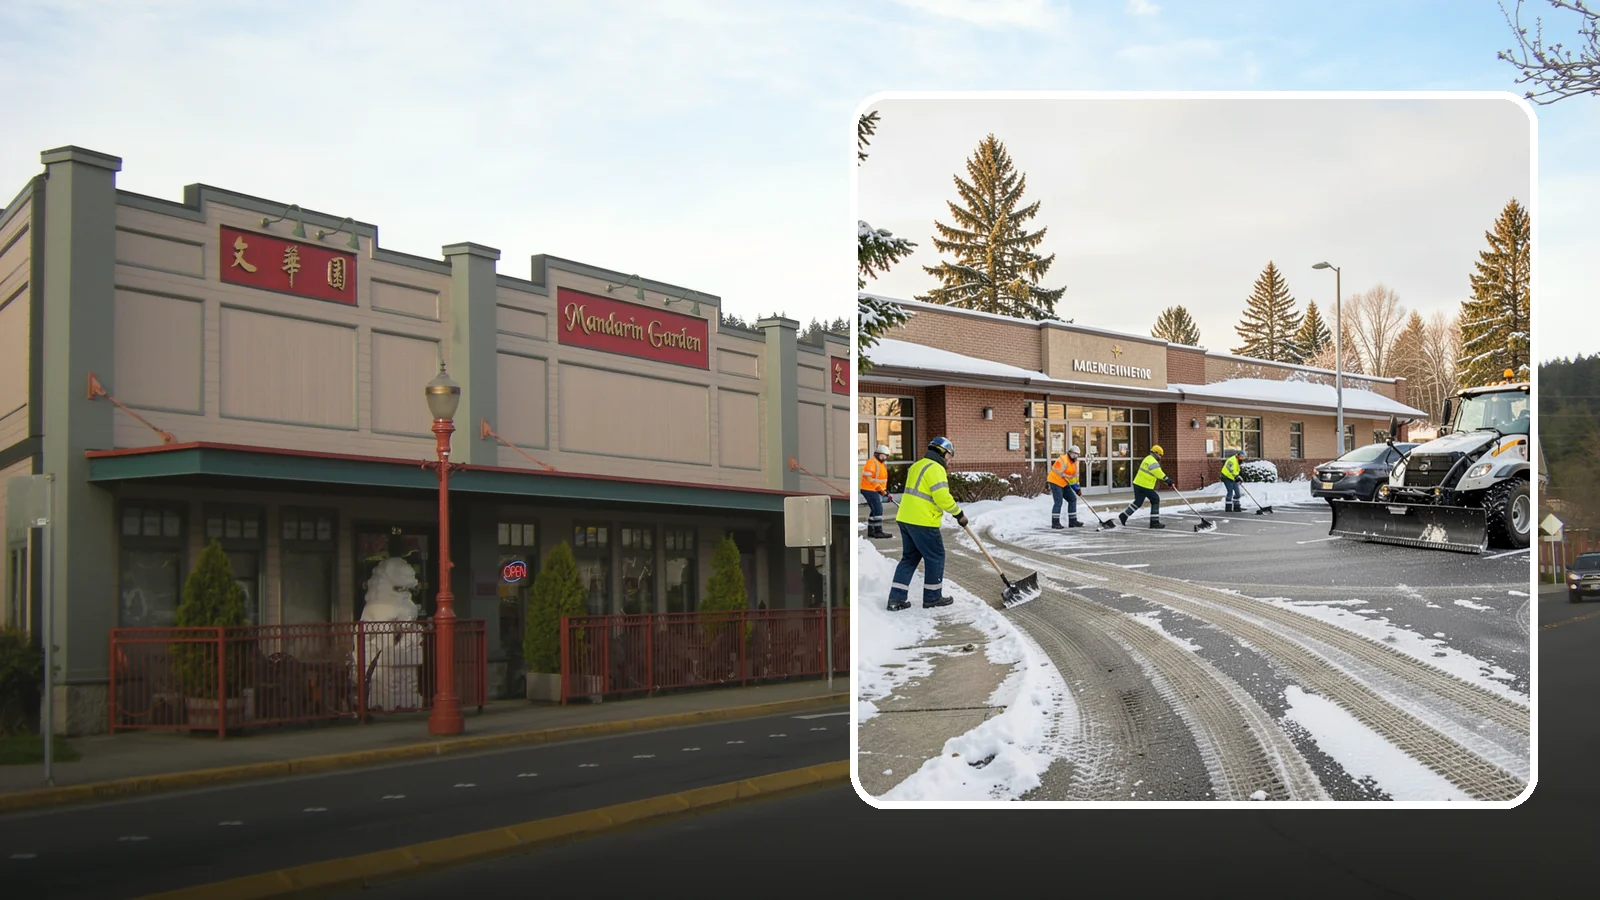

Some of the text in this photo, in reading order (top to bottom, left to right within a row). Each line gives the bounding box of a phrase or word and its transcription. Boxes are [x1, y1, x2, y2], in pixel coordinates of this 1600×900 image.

[230, 235, 346, 291] 文華園
[564, 302, 702, 352] Mandarin Garden
[503, 565, 527, 578] OPEN
